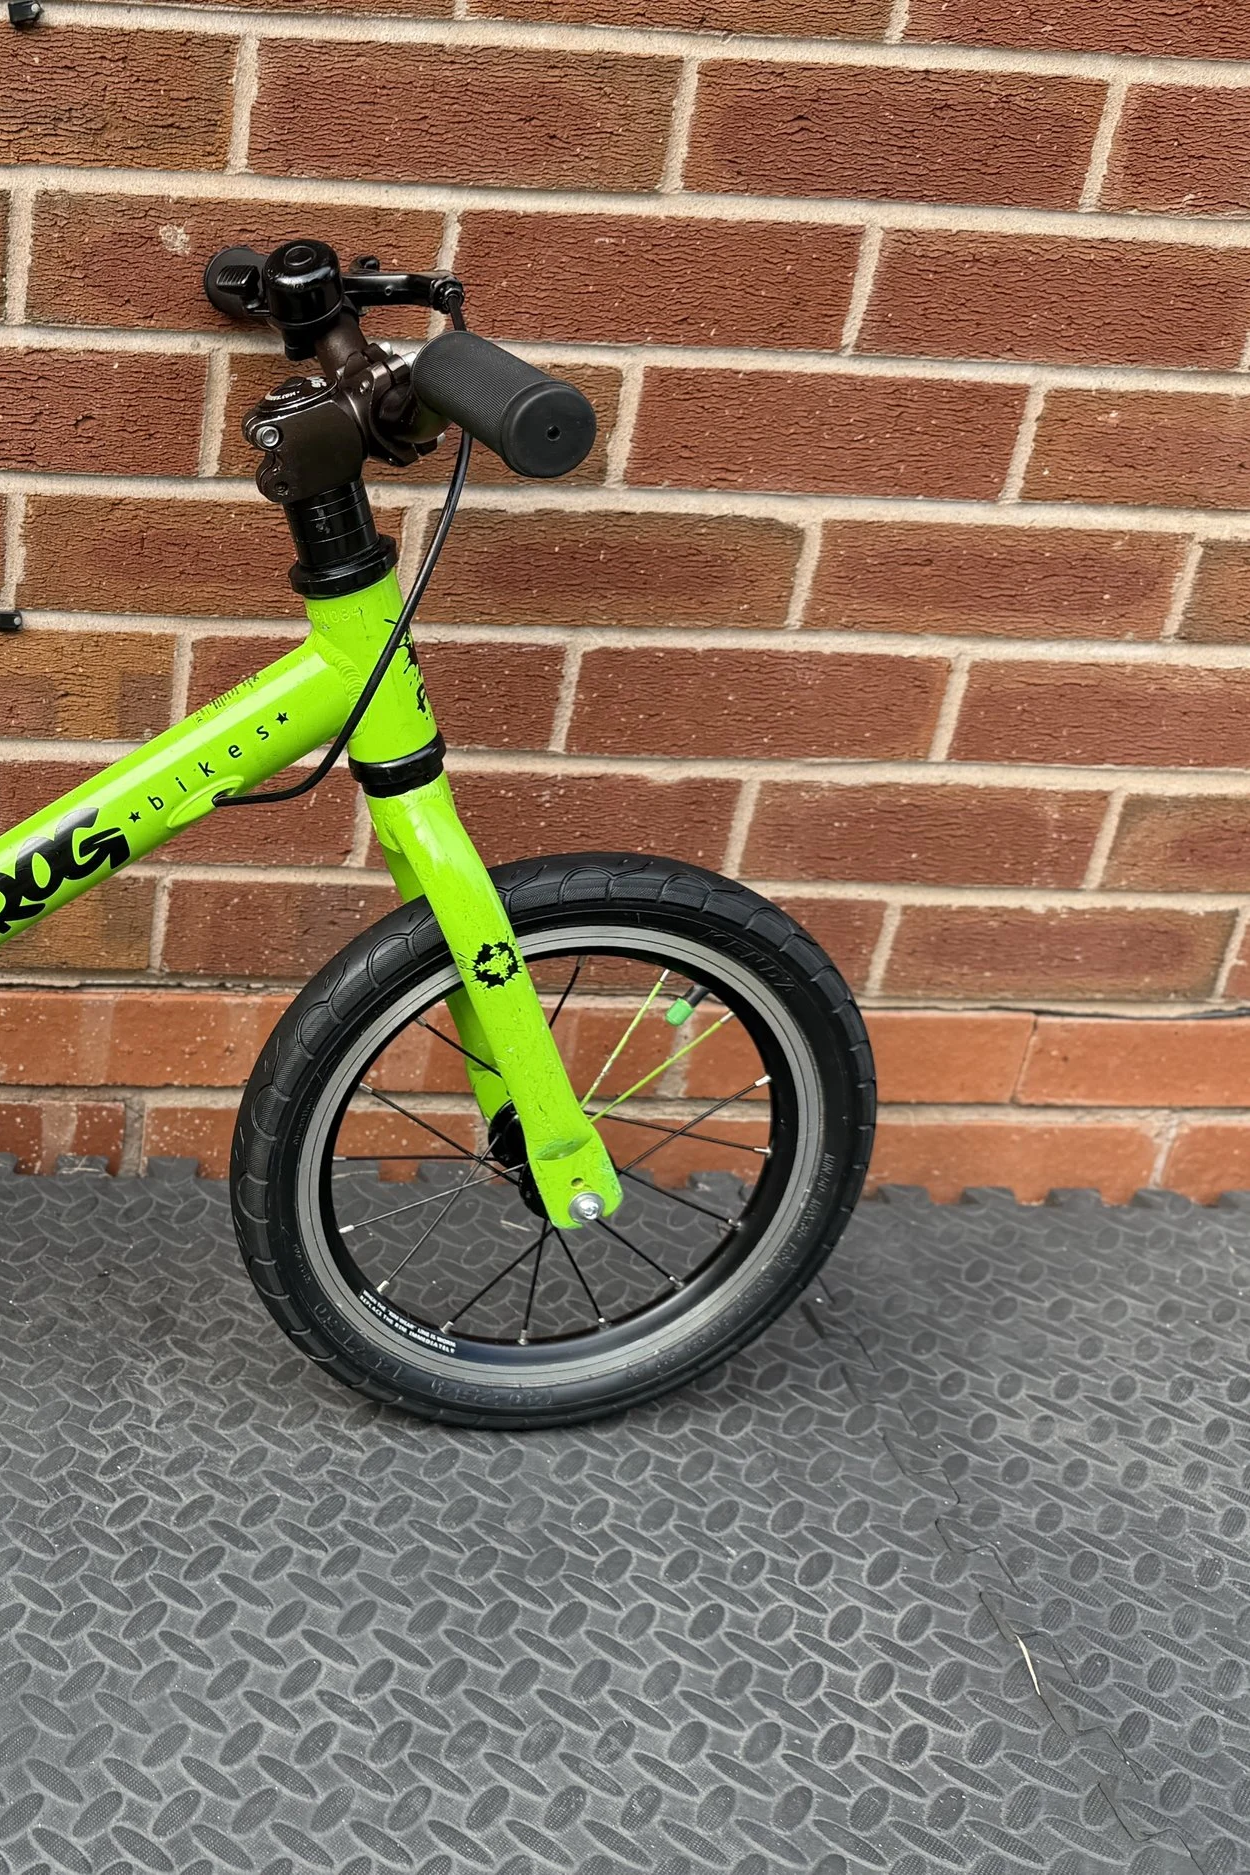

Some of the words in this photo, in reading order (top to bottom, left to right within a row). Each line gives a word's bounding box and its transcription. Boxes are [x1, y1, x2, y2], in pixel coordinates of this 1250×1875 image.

[148, 724, 270, 811] bikes
[359, 1295, 383, 1317] REPLACE
[383, 1314, 394, 1325] THE
[394, 1322, 408, 1333] RIM
[409, 1330, 455, 1354] IMMEDIATELY
